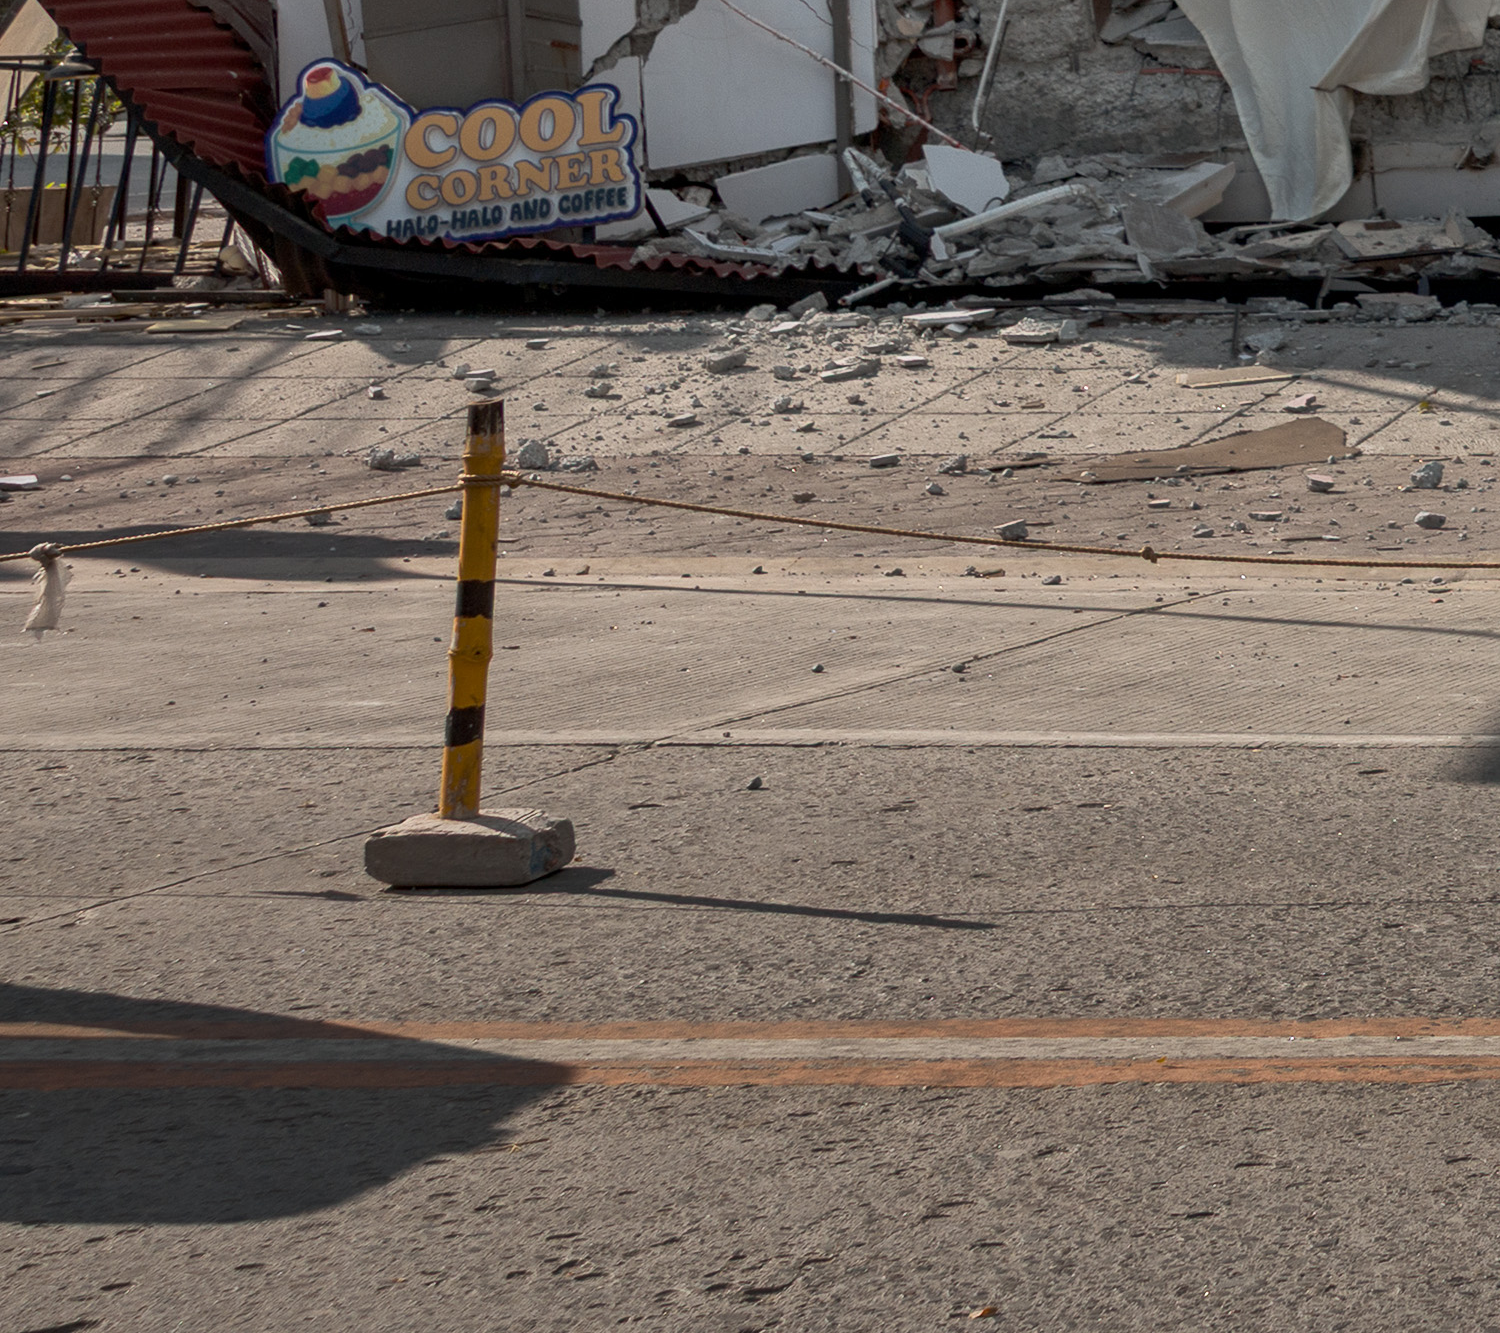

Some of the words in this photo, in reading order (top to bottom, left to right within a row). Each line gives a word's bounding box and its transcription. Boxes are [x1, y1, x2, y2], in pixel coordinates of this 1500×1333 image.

[404, 91, 625, 169] COOL
[405, 147, 625, 211] CORNER
[386, 204, 504, 239] HALO-HALO
[510, 197, 550, 222] AND
[558, 186, 628, 215] COFFEE
